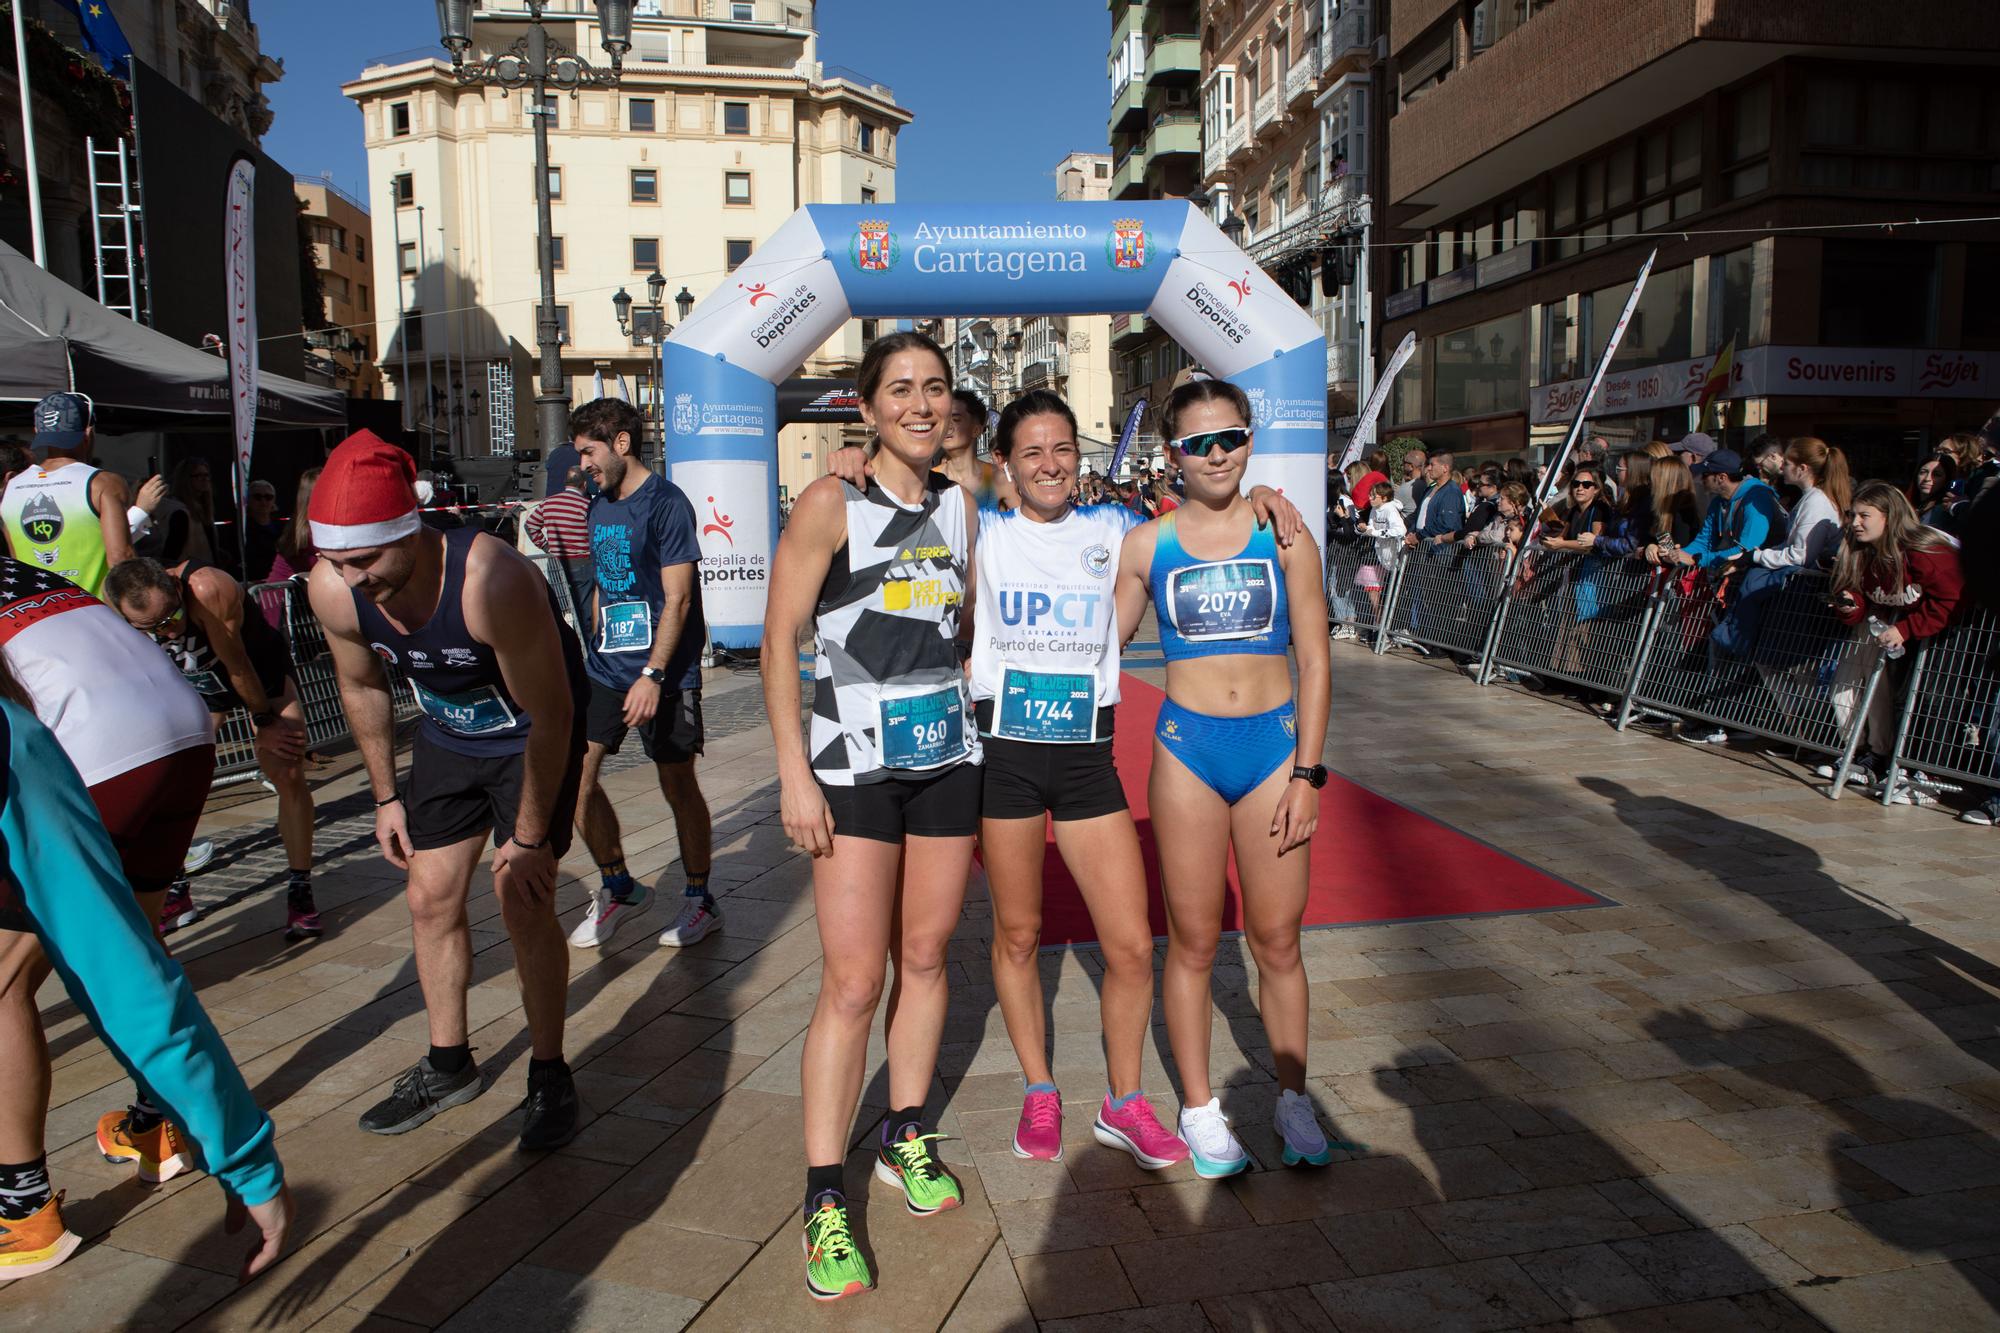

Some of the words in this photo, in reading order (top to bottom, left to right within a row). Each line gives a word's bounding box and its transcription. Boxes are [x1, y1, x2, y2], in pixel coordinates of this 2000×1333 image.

[914, 221, 1087, 245] Ayuntamiento
[914, 244, 1087, 280] Cartagena
[751, 296, 795, 339] Concejalía
[794, 284, 808, 298] de
[1186, 288, 1243, 344] Deportes
[1195, 281, 1239, 324] Concejalía
[1238, 322, 1251, 336] de
[756, 292, 817, 348] Deportes
[1787, 357, 1896, 382] Souvenirs
[1606, 376, 1632, 393] Desde
[1636, 378, 1660, 399] 1950
[702, 402, 763, 413] Ayuntamiento
[702, 412, 763, 426] Cartagena
[750, 554, 765, 565] de
[700, 567, 765, 585] portes
[1246, 579, 1265, 587] 2022
[1000, 582, 1049, 590] UNIVERSIDAD
[999, 591, 1101, 628] UPCT
[1197, 590, 1251, 614] 2079
[610, 621, 635, 636] 1187
[990, 637, 1025, 652] Puerto
[1027, 639, 1045, 652] de
[1048, 639, 1108, 655] Cartagen
[1010, 672, 1030, 687] SAN
[1070, 691, 1089, 699] 2022
[444, 707, 475, 721] 647
[1023, 699, 1073, 720] 1744
[913, 720, 947, 745] 960
